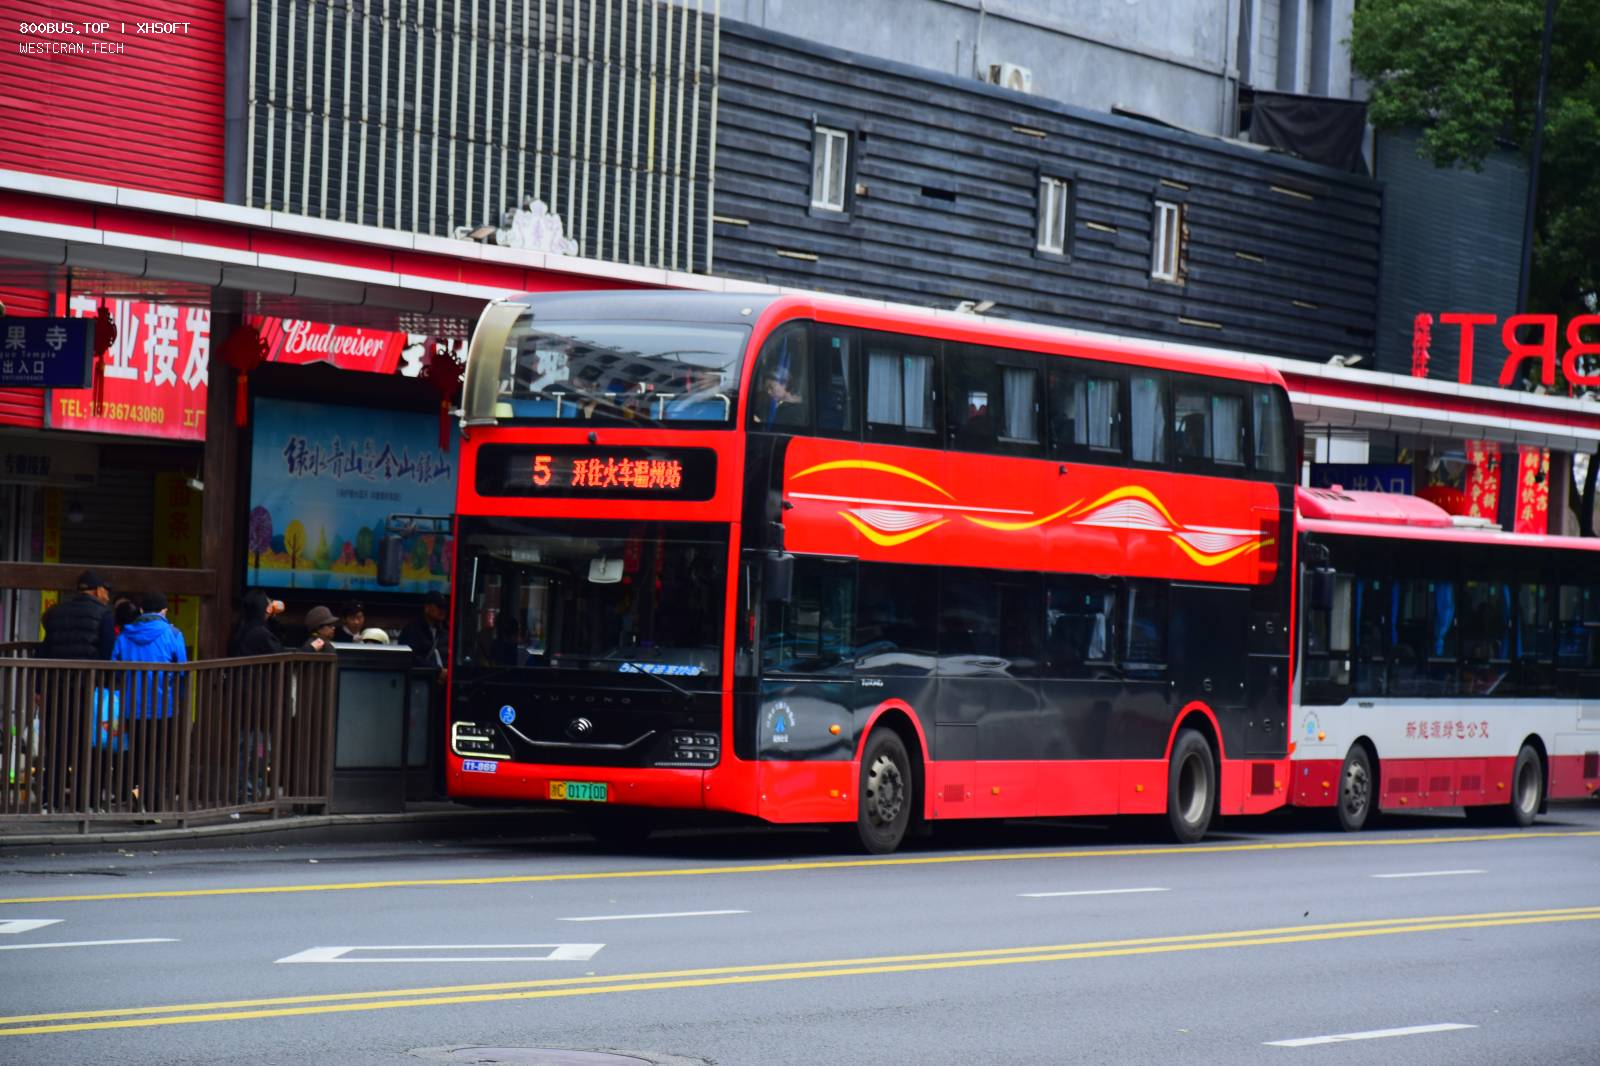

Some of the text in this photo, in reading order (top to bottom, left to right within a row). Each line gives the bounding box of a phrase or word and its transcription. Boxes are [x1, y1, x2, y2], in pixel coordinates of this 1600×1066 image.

[69, 296, 210, 391] 业接发
[281, 319, 384, 357] Budweiser
[2, 359, 44, 374] 出入口
[533, 455, 682, 488] 5 开往火车温州站
[1406, 720, 1489, 740] 新能源绿色公交
